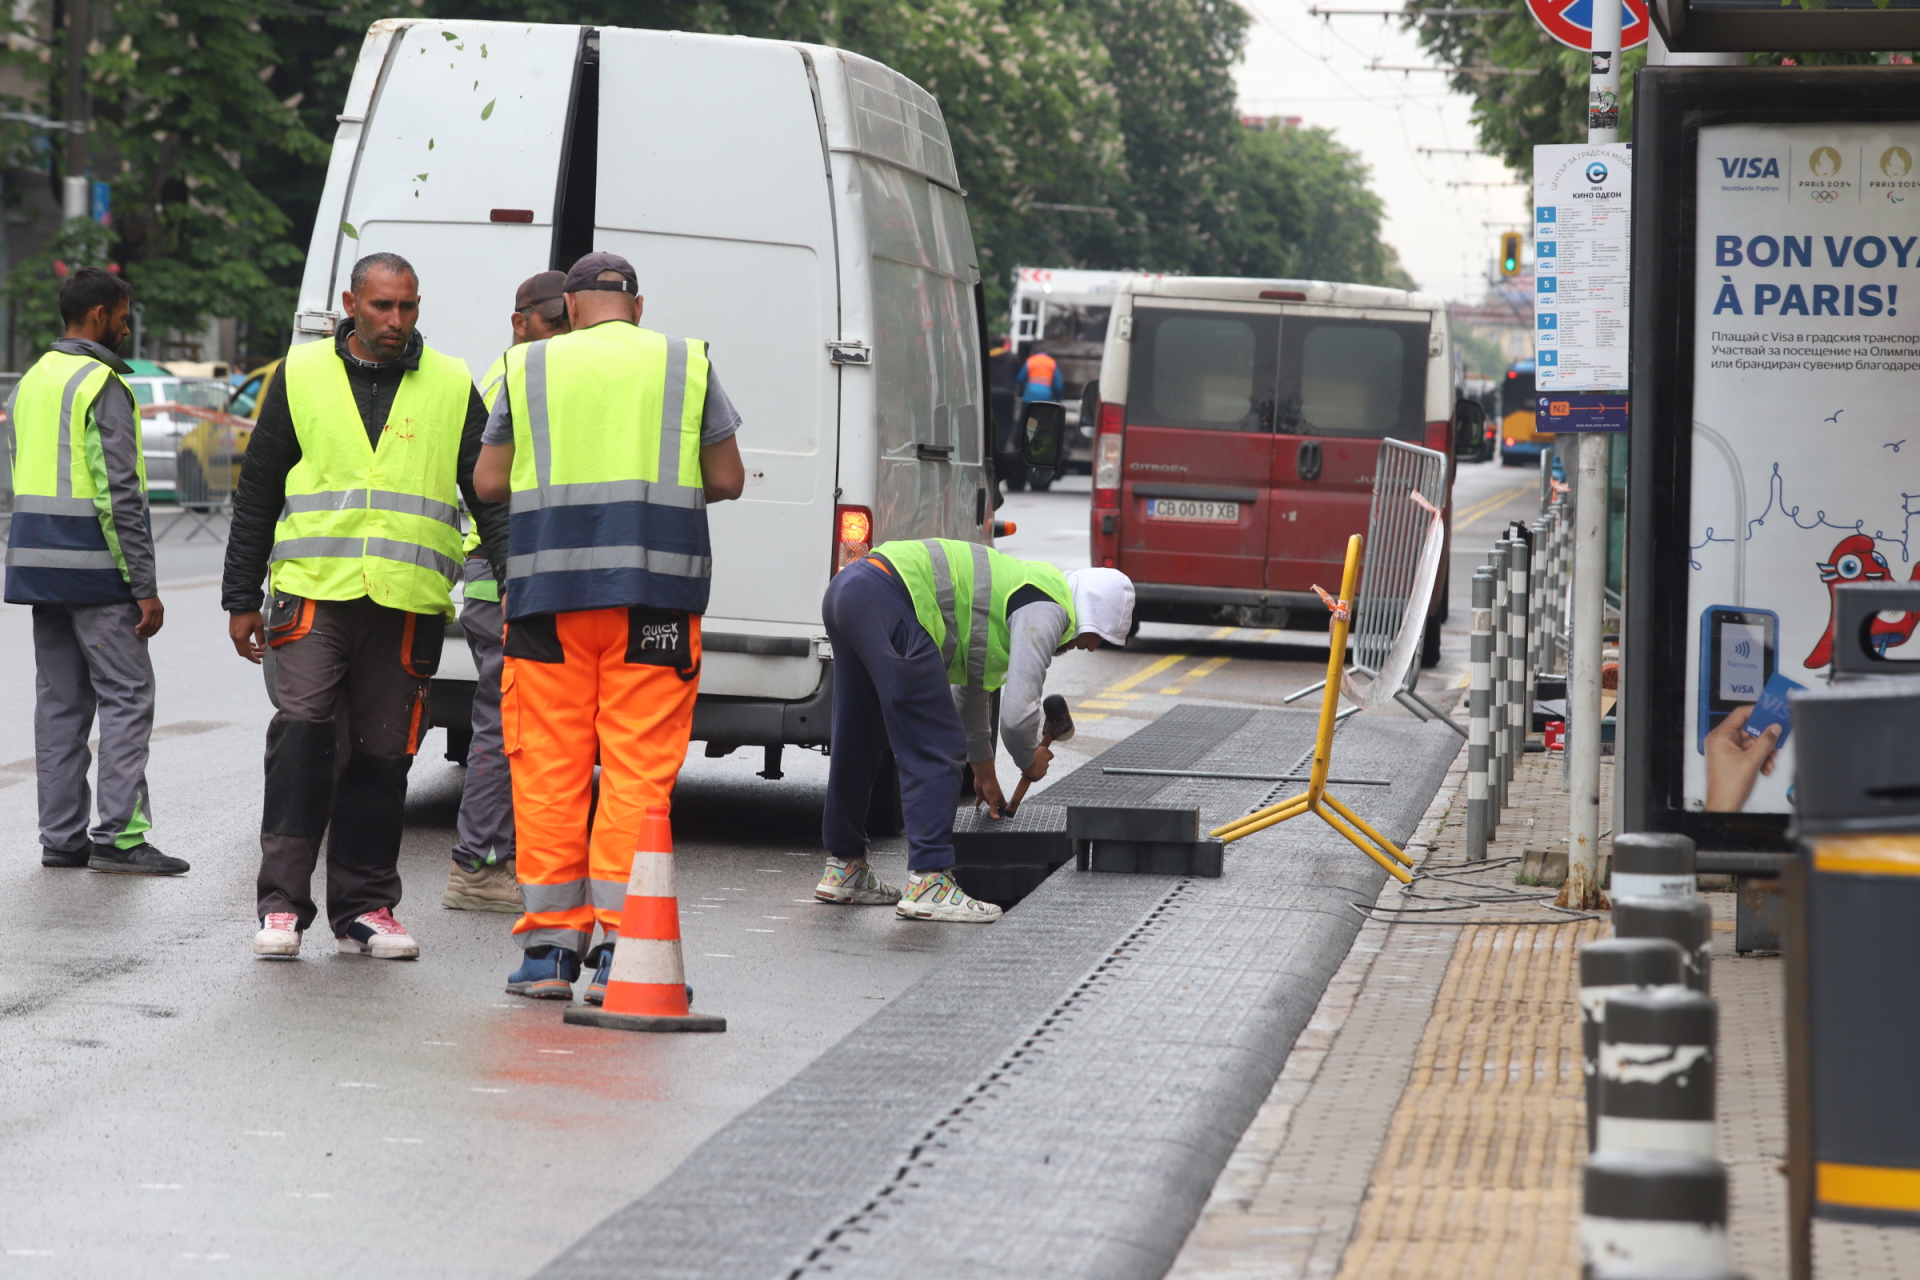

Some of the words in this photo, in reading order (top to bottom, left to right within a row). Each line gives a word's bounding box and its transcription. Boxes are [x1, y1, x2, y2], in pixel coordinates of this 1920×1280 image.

[1568, 156, 1577, 165] ЗА
[1578, 150, 1610, 159] ГРАДСКА
[1716, 157, 1780, 178] VISA
[1715, 235, 1812, 267] BON
[1824, 236, 1920, 268] VOY
[1713, 276, 1743, 315] À
[1754, 284, 1897, 316] PARIS!
[1712, 332, 1759, 343] Плащай
[1771, 332, 1794, 342] Visa
[1797, 334, 1803, 342] в
[1806, 334, 1861, 344] градския
[1864, 334, 1920, 344] транспор
[1712, 345, 1765, 356] Участвай
[1768, 348, 1781, 356] за
[1783, 348, 1851, 357] посещение
[1854, 348, 1867, 356] на
[1870, 347, 1920, 356] Олимпи
[1711, 361, 1733, 369] или
[1736, 359, 1801, 370] брандиран
[1803, 361, 1853, 372] сувенир
[1856, 360, 1920, 372] благодаре
[1553, 405, 1566, 413] N2
[1130, 462, 1188, 473] CITROËN
[1179, 502, 1214, 518] 0019
[642, 623, 678, 636] QUICK
[641, 634, 678, 650] CITY
[1730, 684, 1754, 694] VISA
[1762, 693, 1793, 721] VIS
